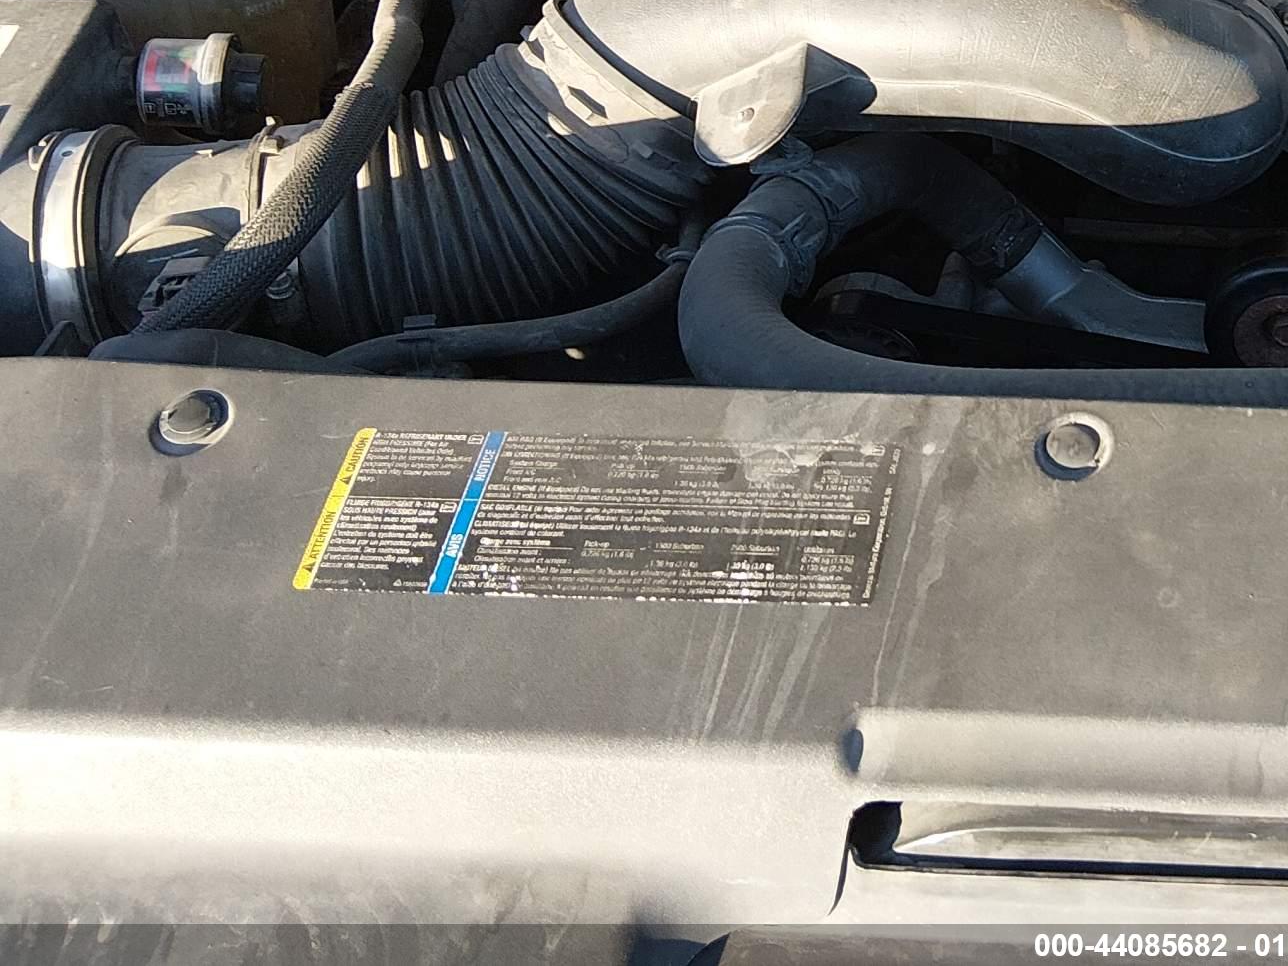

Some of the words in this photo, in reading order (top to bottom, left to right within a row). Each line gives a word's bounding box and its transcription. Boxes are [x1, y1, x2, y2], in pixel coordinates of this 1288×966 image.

[347, 436, 369, 475] CAUTION
[474, 448, 496, 482] NOTICE
[310, 510, 338, 559] ATTENTION
[445, 533, 464, 557] AVIS
